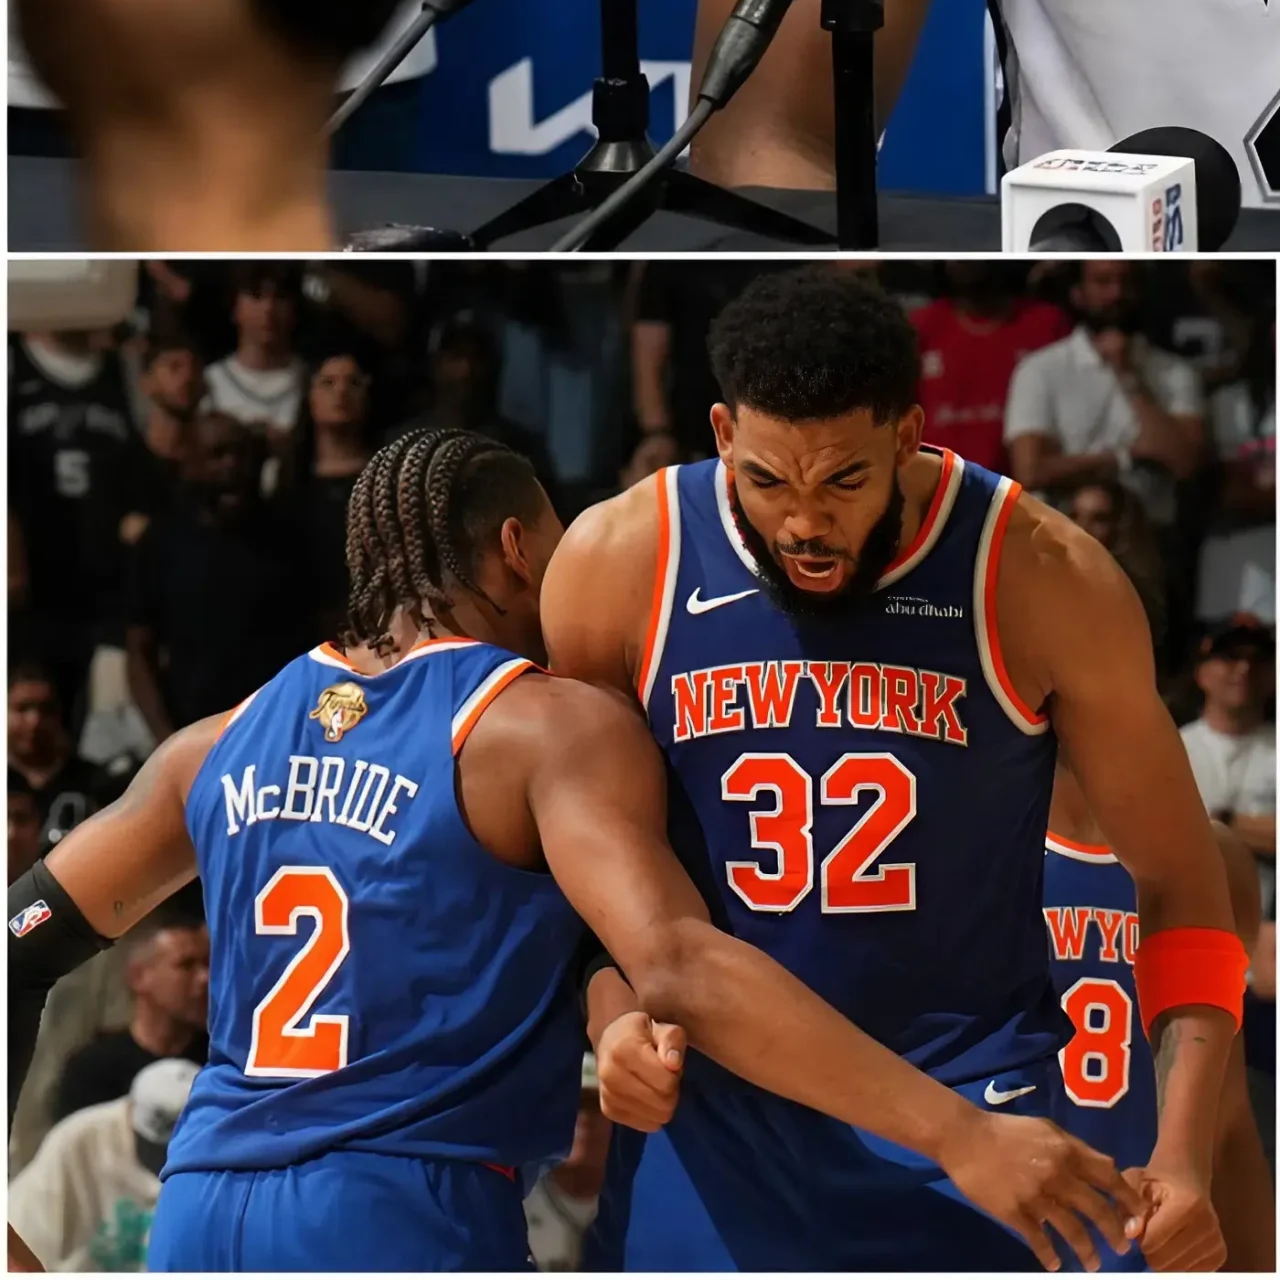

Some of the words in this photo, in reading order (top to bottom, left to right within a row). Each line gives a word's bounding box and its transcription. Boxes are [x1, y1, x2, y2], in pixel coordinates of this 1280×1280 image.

[671, 660, 801, 743] NEW
[803, 661, 968, 747] YORK
[220, 755, 419, 846] McBRIDE
[720, 752, 917, 913] 32
[244, 865, 349, 1078] 2
[1057, 977, 1132, 1109] 8
